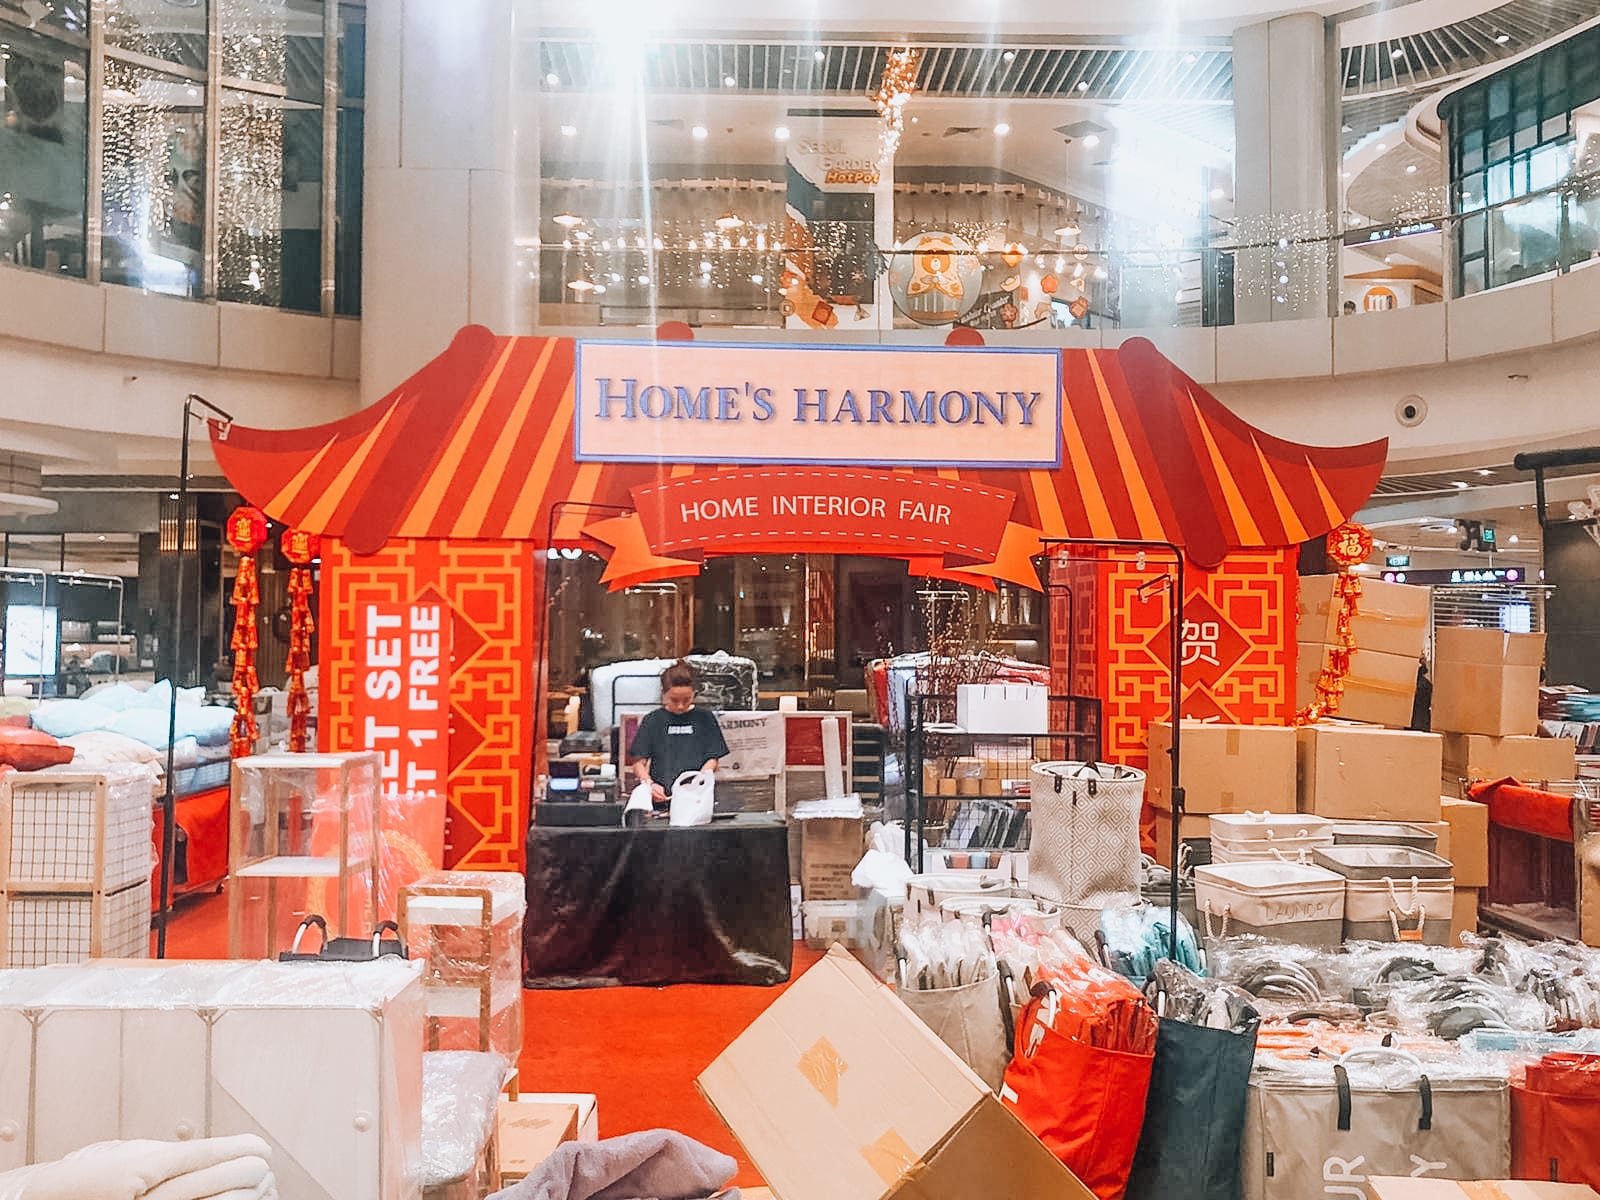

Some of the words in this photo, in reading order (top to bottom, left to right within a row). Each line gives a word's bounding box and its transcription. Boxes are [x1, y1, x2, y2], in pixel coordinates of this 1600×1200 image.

[594, 377, 775, 422] HOME'S
[793, 387, 1042, 426] HARMONY
[680, 496, 760, 523] HOME
[771, 495, 887, 518] INTERIOR
[899, 500, 952, 525] FAIR
[1338, 530, 1363, 557] 福
[365, 605, 402, 700] SET
[408, 606, 440, 710] FREE
[1181, 619, 1220, 666] 贺
[407, 729, 438, 748] 1
